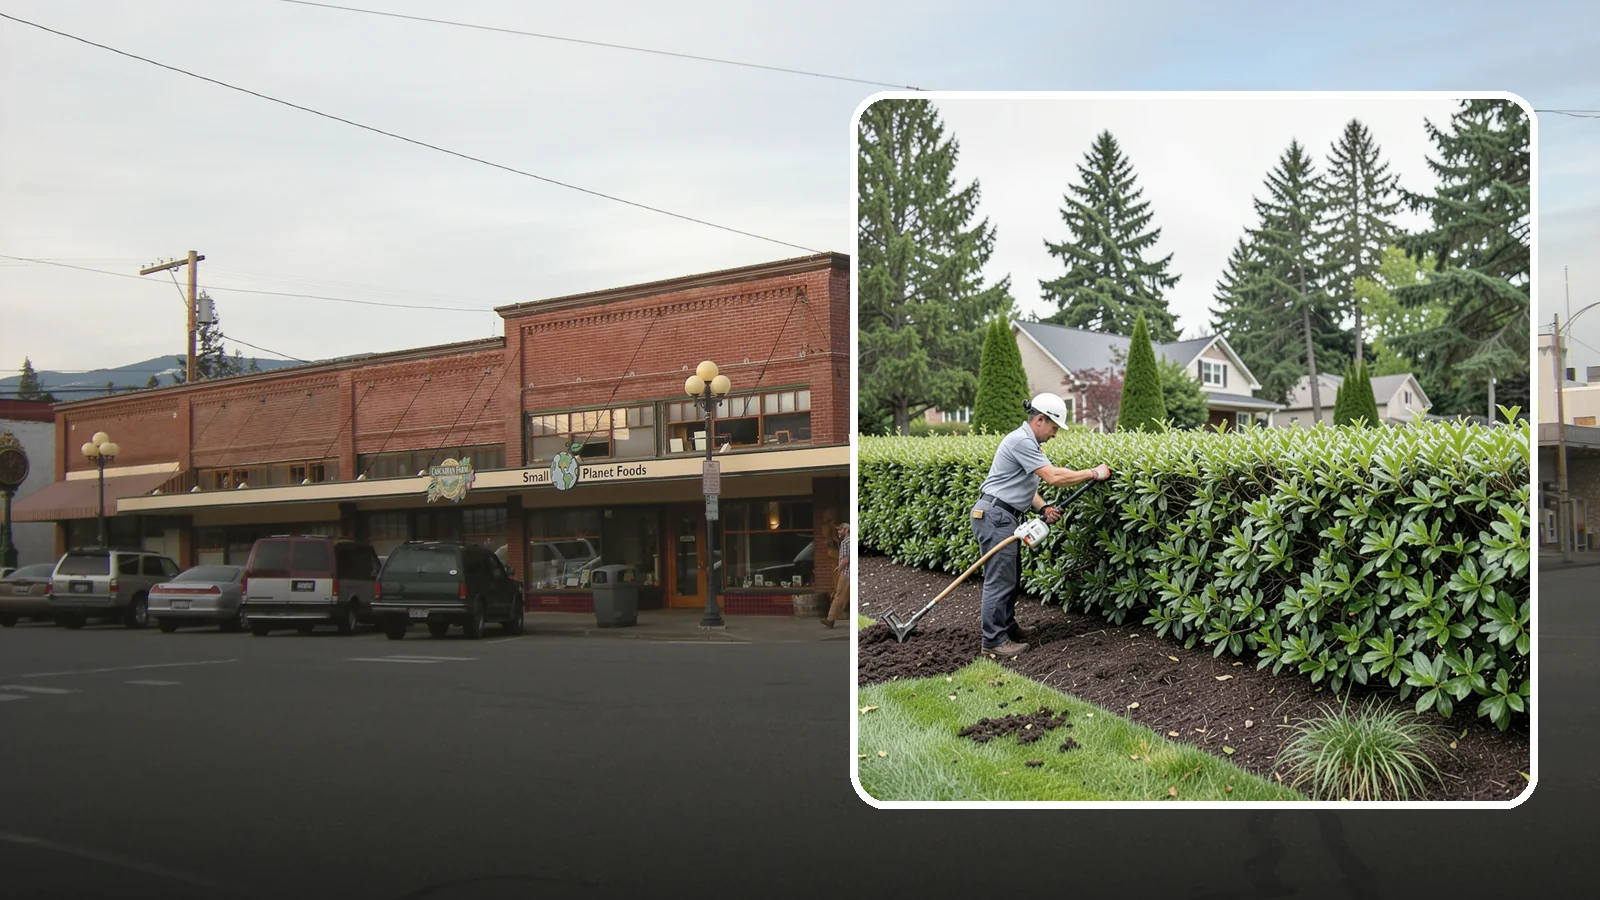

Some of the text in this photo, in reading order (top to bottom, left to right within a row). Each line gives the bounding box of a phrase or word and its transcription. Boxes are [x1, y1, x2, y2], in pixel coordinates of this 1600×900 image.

[523, 464, 647, 483] Small Planet Foods
